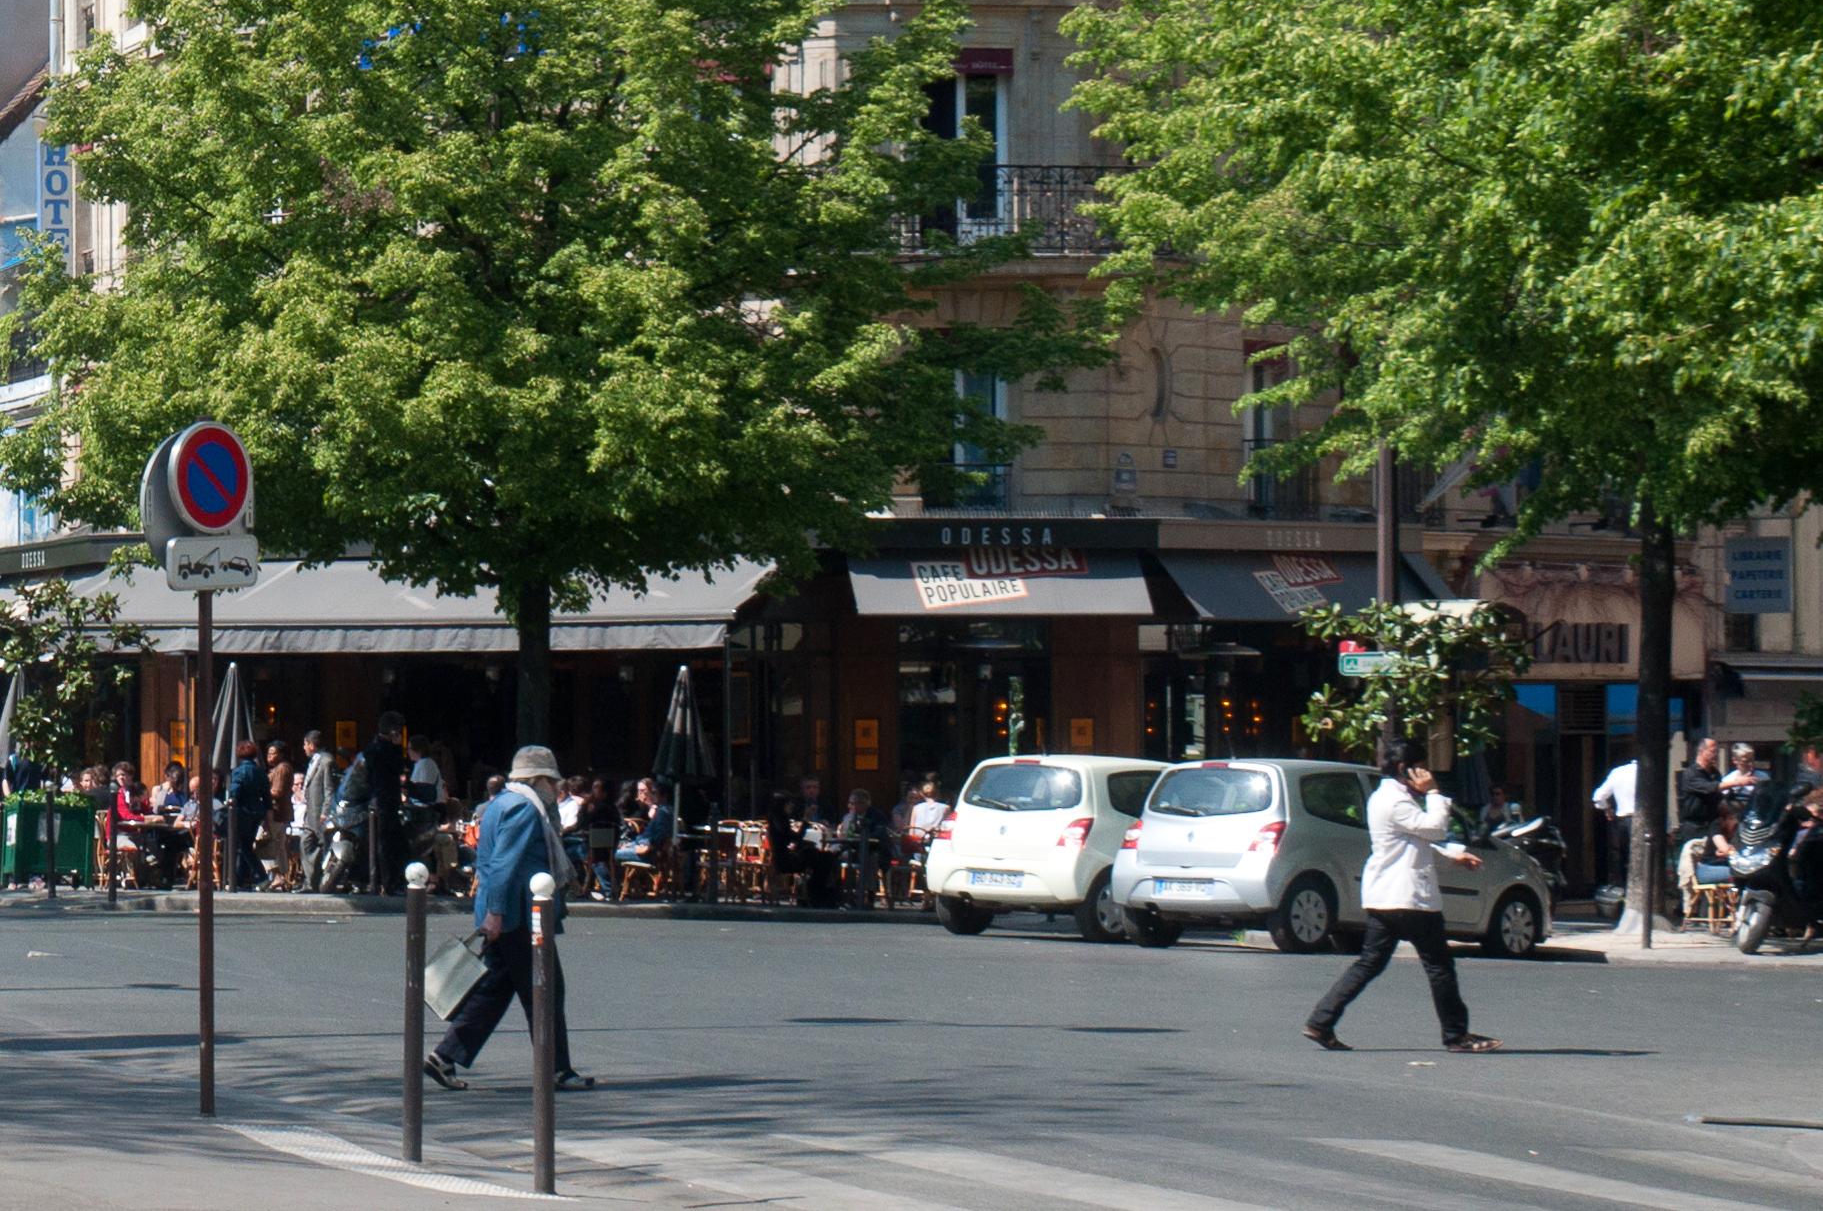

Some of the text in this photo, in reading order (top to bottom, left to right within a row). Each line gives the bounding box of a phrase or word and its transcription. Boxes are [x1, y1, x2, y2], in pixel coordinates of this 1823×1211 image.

[44, 143, 70, 274] HOTE
[941, 527, 1053, 545] ODESSA
[21, 550, 45, 569] ODESSA
[969, 547, 1078, 576] ODESSA
[1732, 550, 1783, 561] LIBRAIRIE
[917, 564, 964, 584] CAFE
[1731, 570, 1784, 581] PAPETERIE
[924, 578, 1022, 605] POPULAIRE
